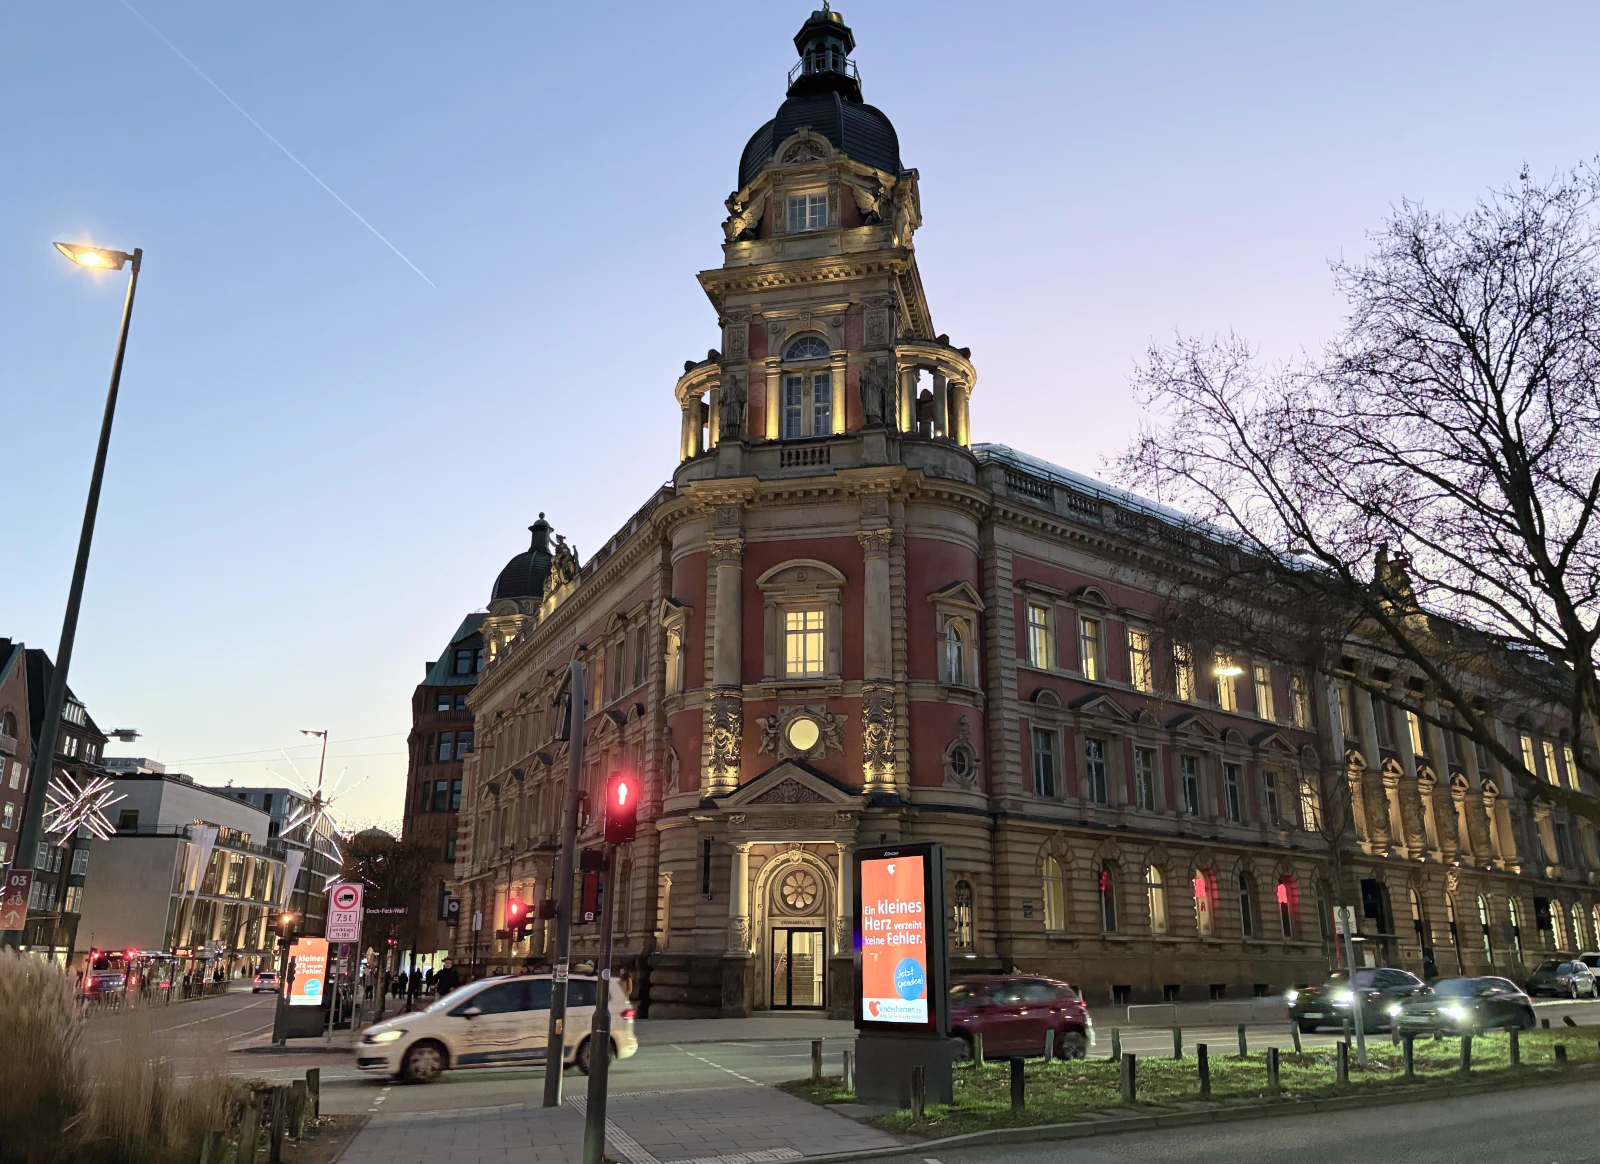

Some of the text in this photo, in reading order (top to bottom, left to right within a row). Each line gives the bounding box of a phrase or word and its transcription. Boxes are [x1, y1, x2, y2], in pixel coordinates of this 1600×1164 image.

[11, 875, 27, 886] 03
[864, 898, 922, 915] Ein kleines
[864, 916, 923, 931] Herz verzeiht
[864, 931, 923, 946] keine Fehler.
[896, 966, 914, 979] Jetzt
[897, 974, 924, 993] spenden!
